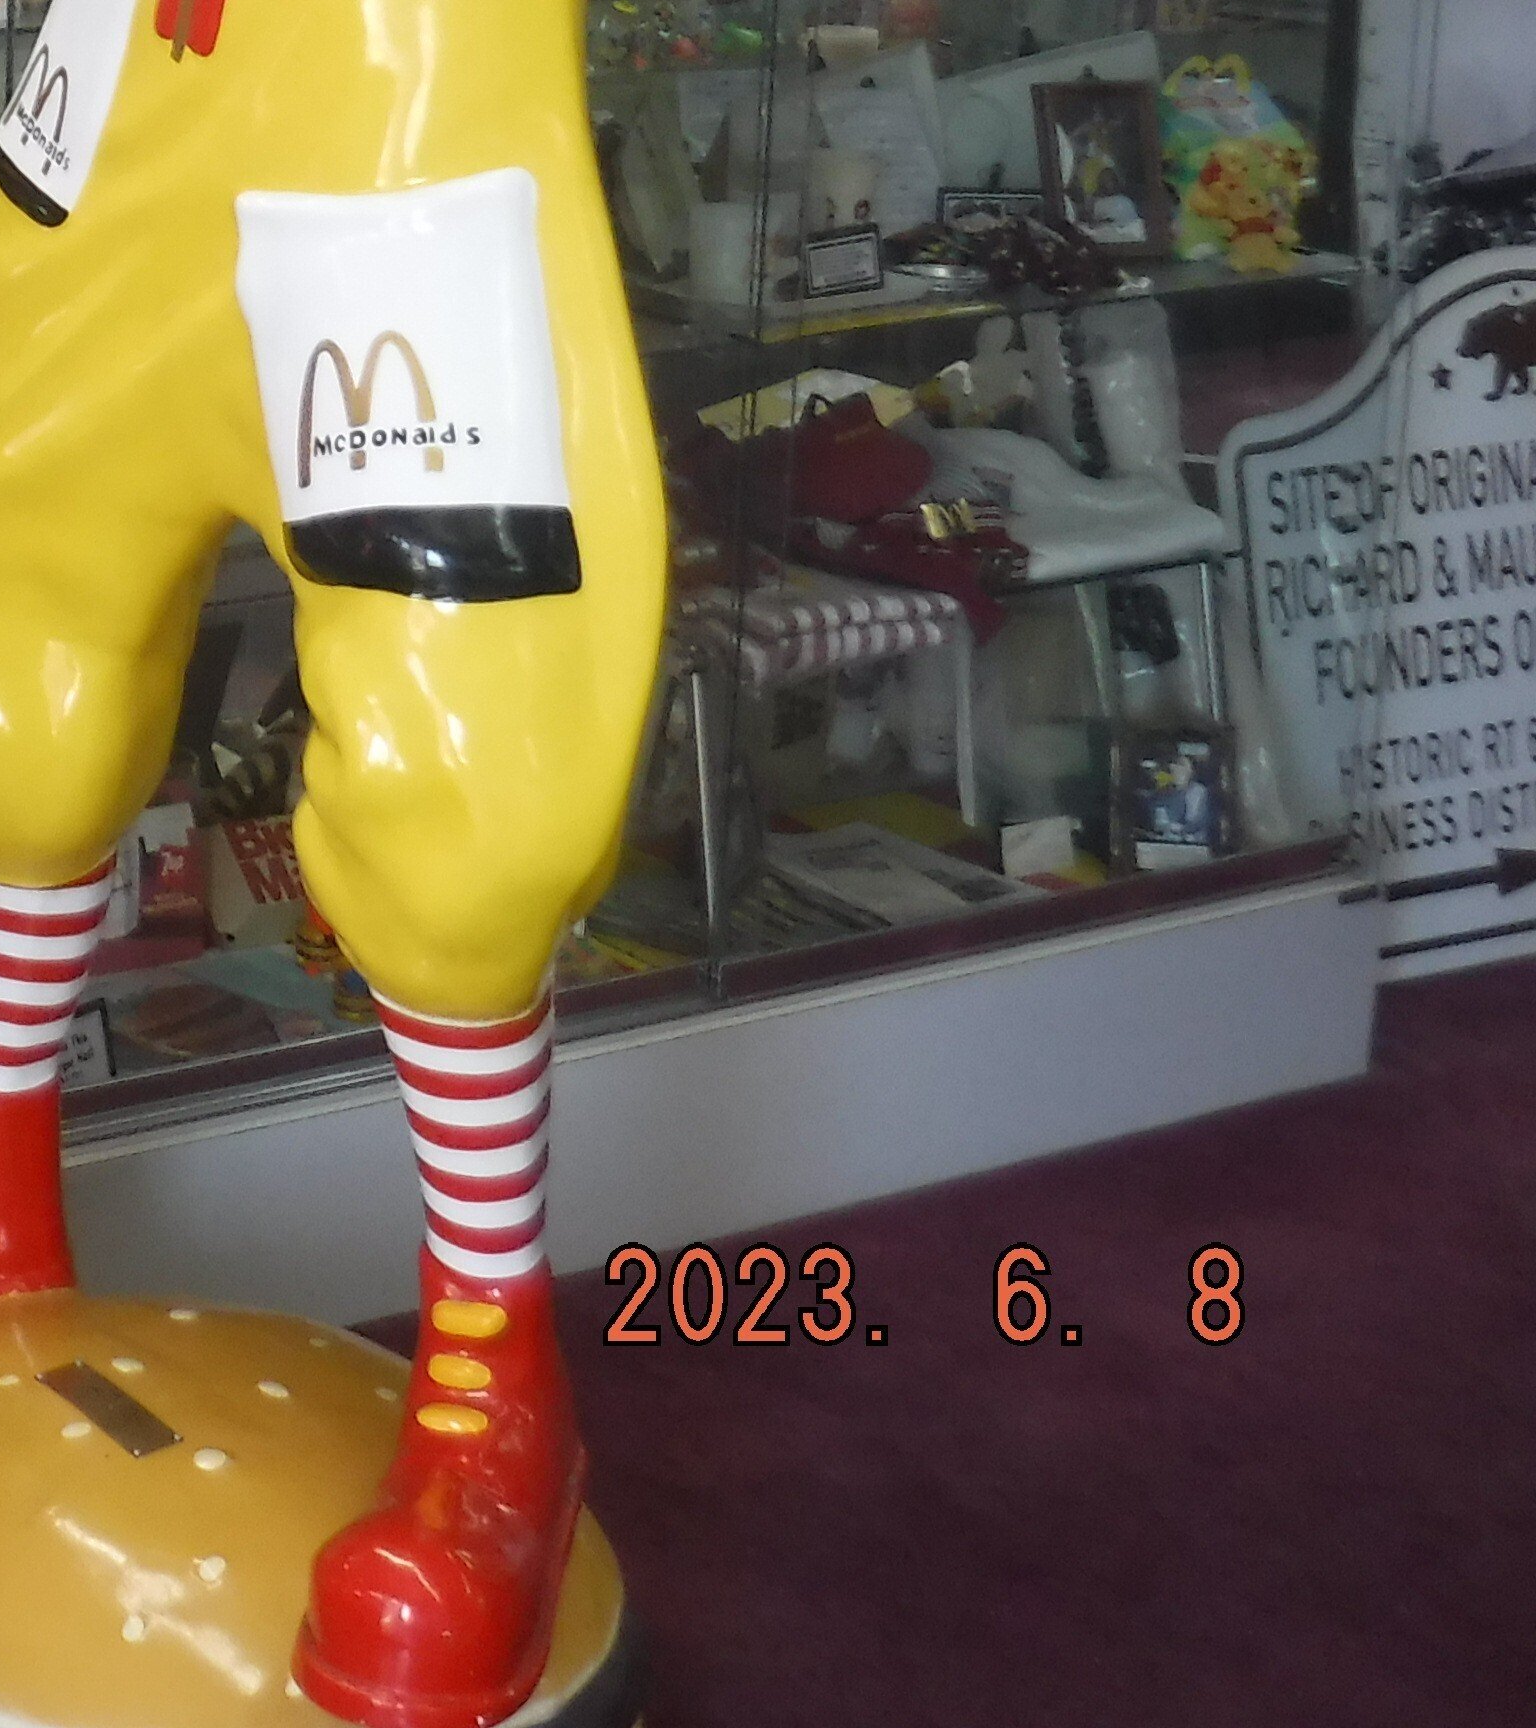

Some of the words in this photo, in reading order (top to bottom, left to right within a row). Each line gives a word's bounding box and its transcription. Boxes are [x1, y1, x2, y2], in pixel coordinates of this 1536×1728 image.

[1265, 539, 1419, 625] RICHARD
[1314, 613, 1503, 705] FOUNDERS
[1349, 794, 1459, 853] SINESS
